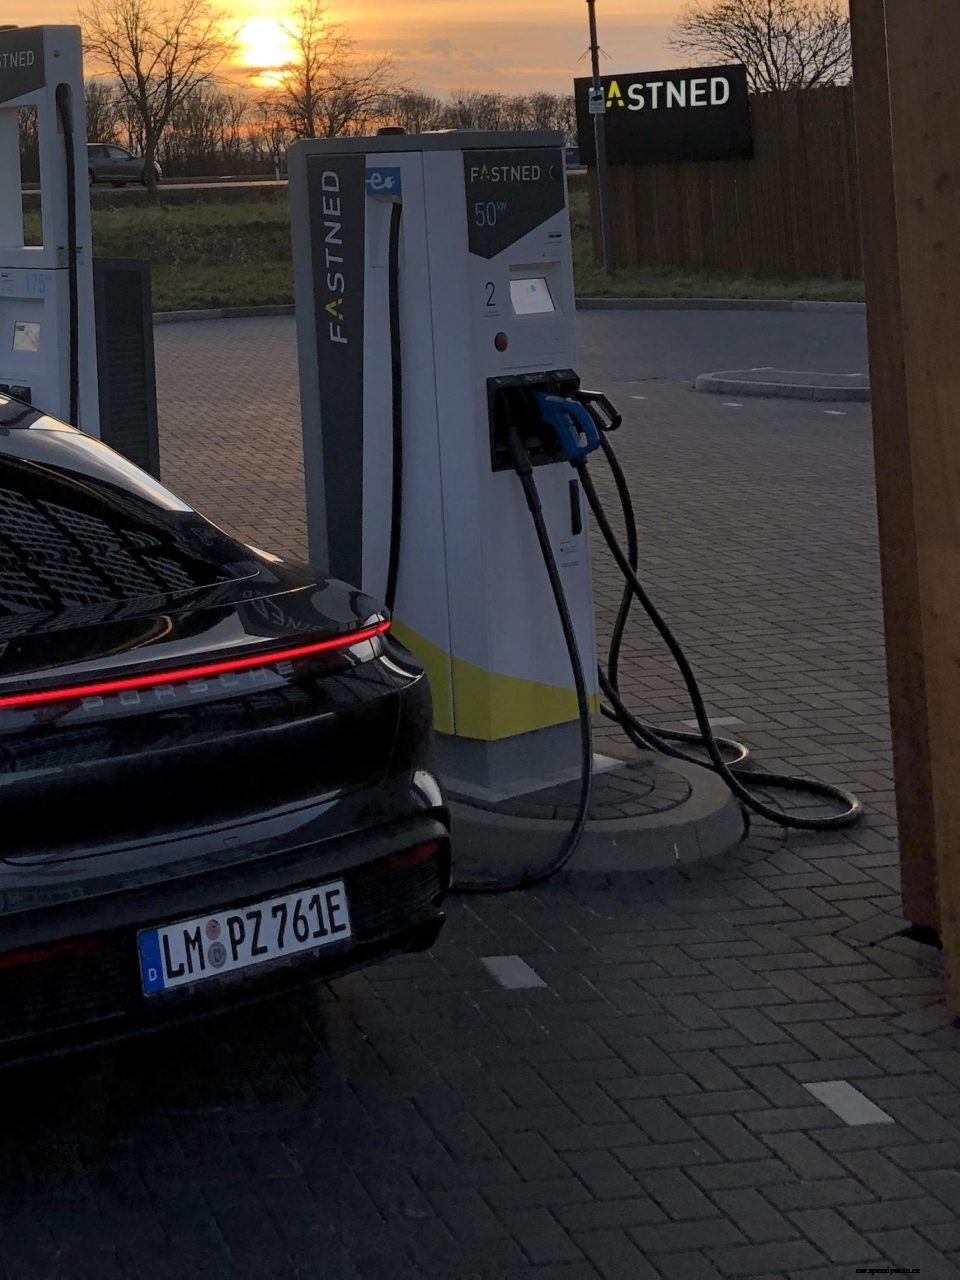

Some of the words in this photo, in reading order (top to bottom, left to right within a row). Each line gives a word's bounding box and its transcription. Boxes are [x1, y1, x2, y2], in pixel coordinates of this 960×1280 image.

[605, 76, 731, 111] ASTNED
[470, 164, 541, 182] FASTNED
[474, 201, 497, 226] 50
[321, 170, 348, 344] FASTNED
[25, 272, 47, 294] 175
[485, 281, 496, 307] 2
[80, 660, 295, 712] PORSCHE
[161, 925, 206, 979] LM
[226, 909, 268, 962] PZ
[271, 889, 347, 949] 761E
[148, 967, 157, 982] D
